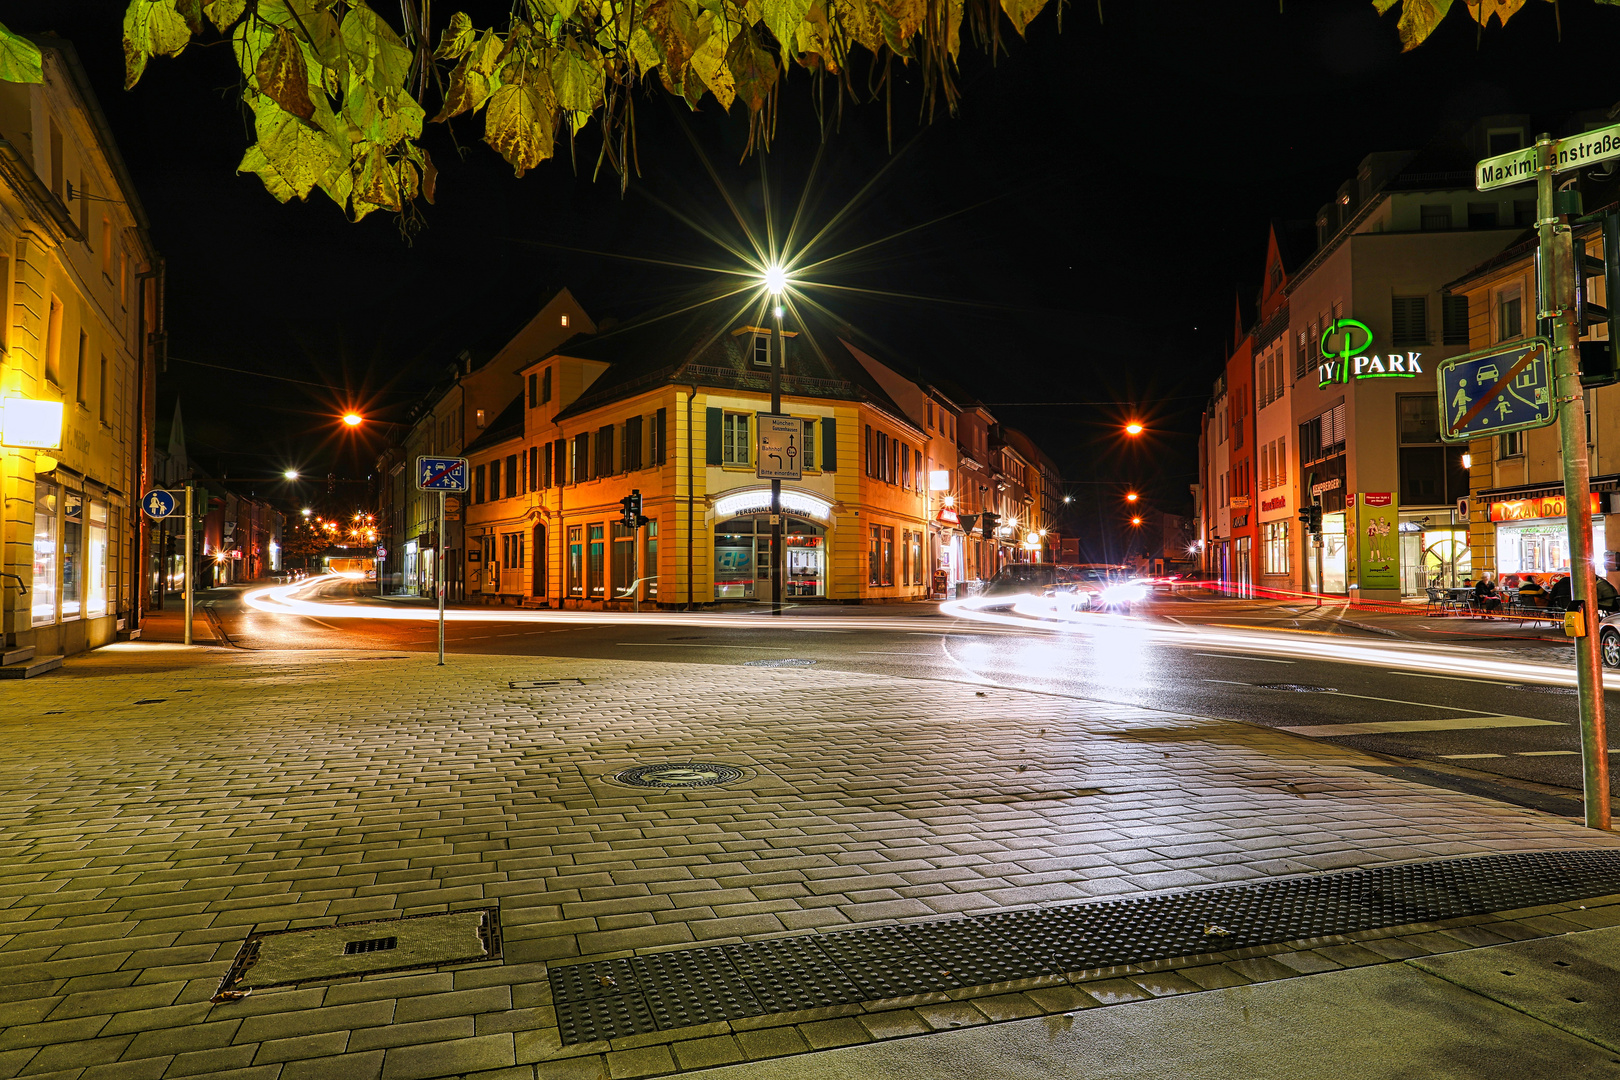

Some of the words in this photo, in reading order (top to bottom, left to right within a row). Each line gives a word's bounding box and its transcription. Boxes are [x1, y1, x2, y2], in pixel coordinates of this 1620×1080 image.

[1482, 134, 1620, 184] Maximianstraße
[1353, 352, 1422, 375] PARK
[772, 419, 795, 427] München
